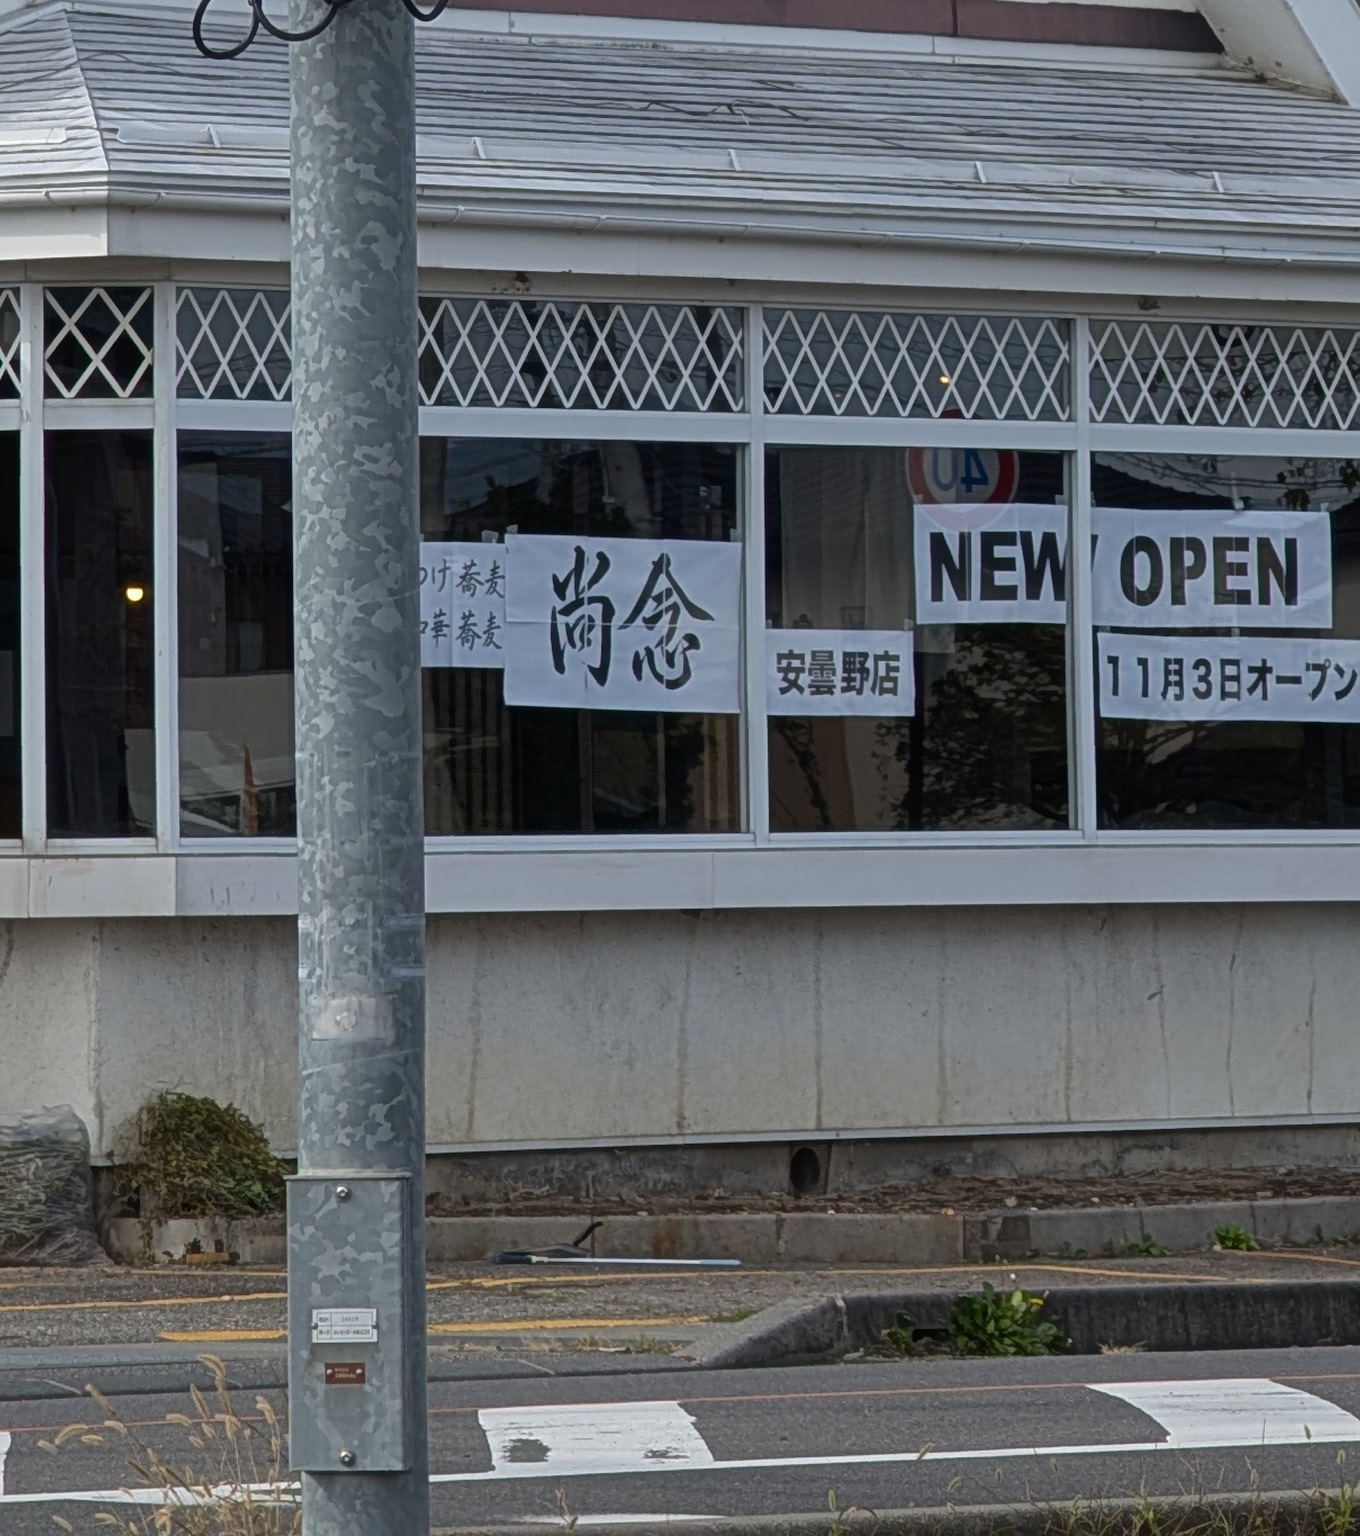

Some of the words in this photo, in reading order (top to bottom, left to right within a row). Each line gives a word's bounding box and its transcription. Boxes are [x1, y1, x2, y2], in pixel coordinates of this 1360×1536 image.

[929, 530, 1098, 602] NEW
[1121, 535, 1299, 607] OPEN
[550, 545, 715, 690] 尚念
[775, 649, 902, 697] 安曇野店
[1107, 655, 1358, 702] 11月3日オープン
